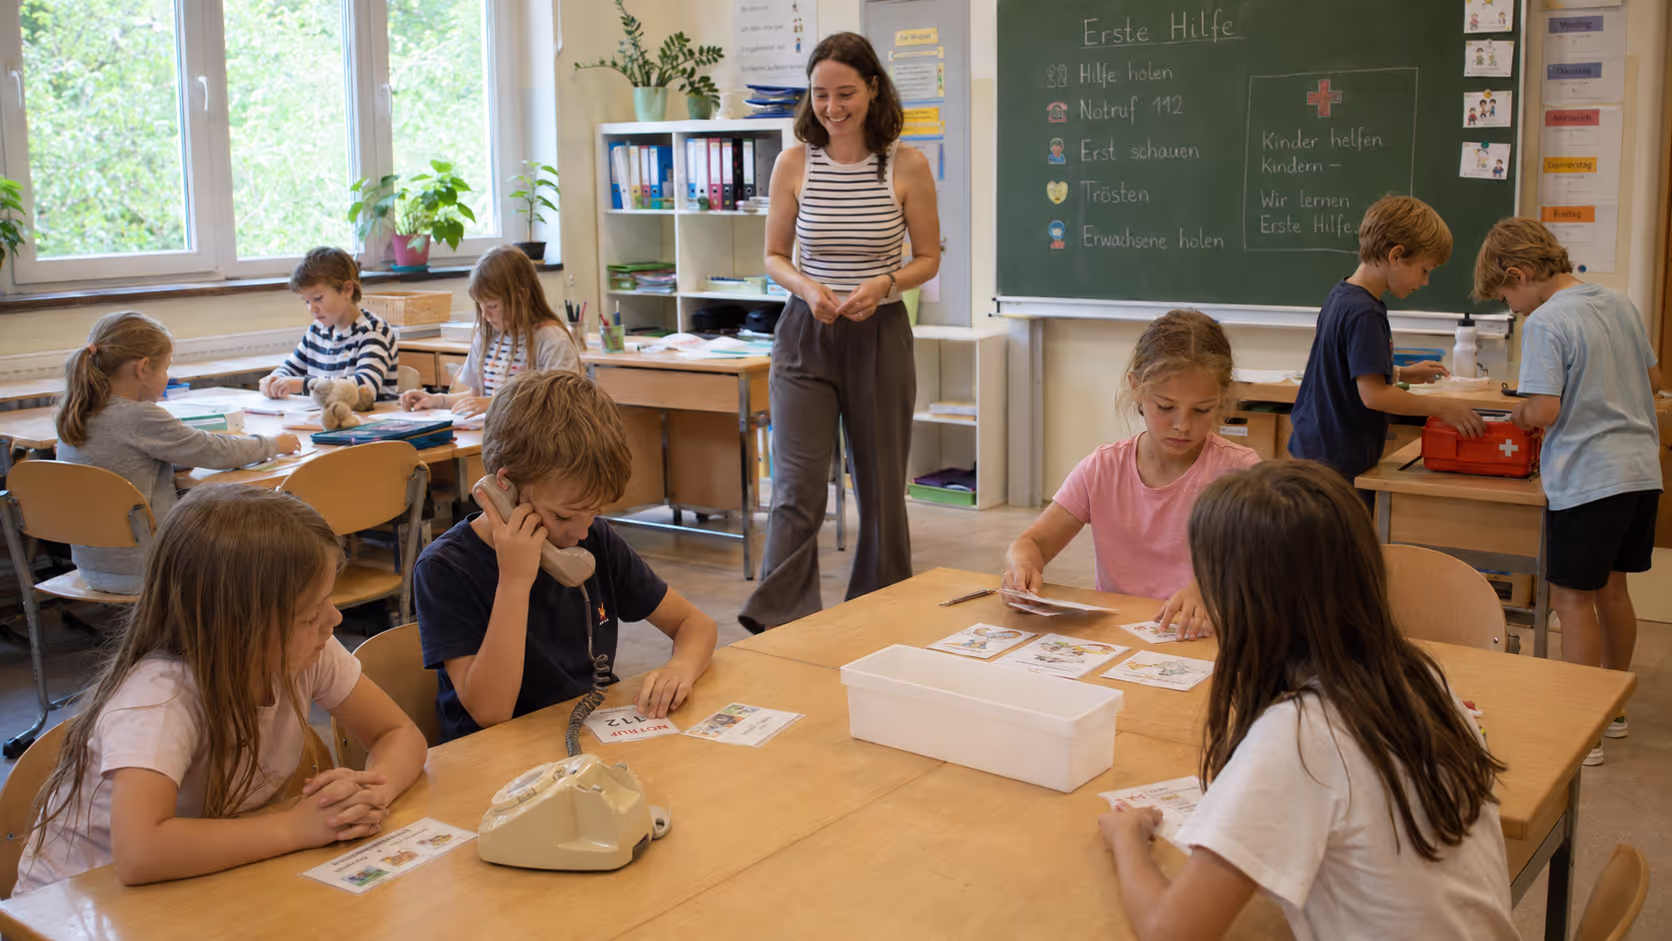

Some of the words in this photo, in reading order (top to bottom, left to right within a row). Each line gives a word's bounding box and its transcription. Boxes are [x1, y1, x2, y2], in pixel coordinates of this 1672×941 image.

[1083, 17, 1150, 46] Erste
[1170, 8, 1235, 43] Hilfe
[1079, 62, 1118, 88] Hilfe
[1128, 60, 1173, 81] holen
[1080, 95, 1138, 125] Notruf
[1152, 94, 1184, 115] 112
[1080, 137, 1117, 162] Erst
[1130, 137, 1200, 160] schauen
[1262, 129, 1319, 150] Kinder
[1330, 126, 1383, 152] helfen
[1261, 155, 1323, 174] Kindern
[1080, 180, 1150, 203] Trösten
[1259, 188, 1288, 209] Wir
[1300, 190, 1351, 209] lernen
[1083, 224, 1167, 250] Erwachsene
[1179, 226, 1224, 249] holen
[1260, 214, 1301, 234] Erste
[1313, 214, 1358, 237] Hilfe.
[604, 715, 647, 727] 112
[609, 723, 669, 737] NOTRUF
